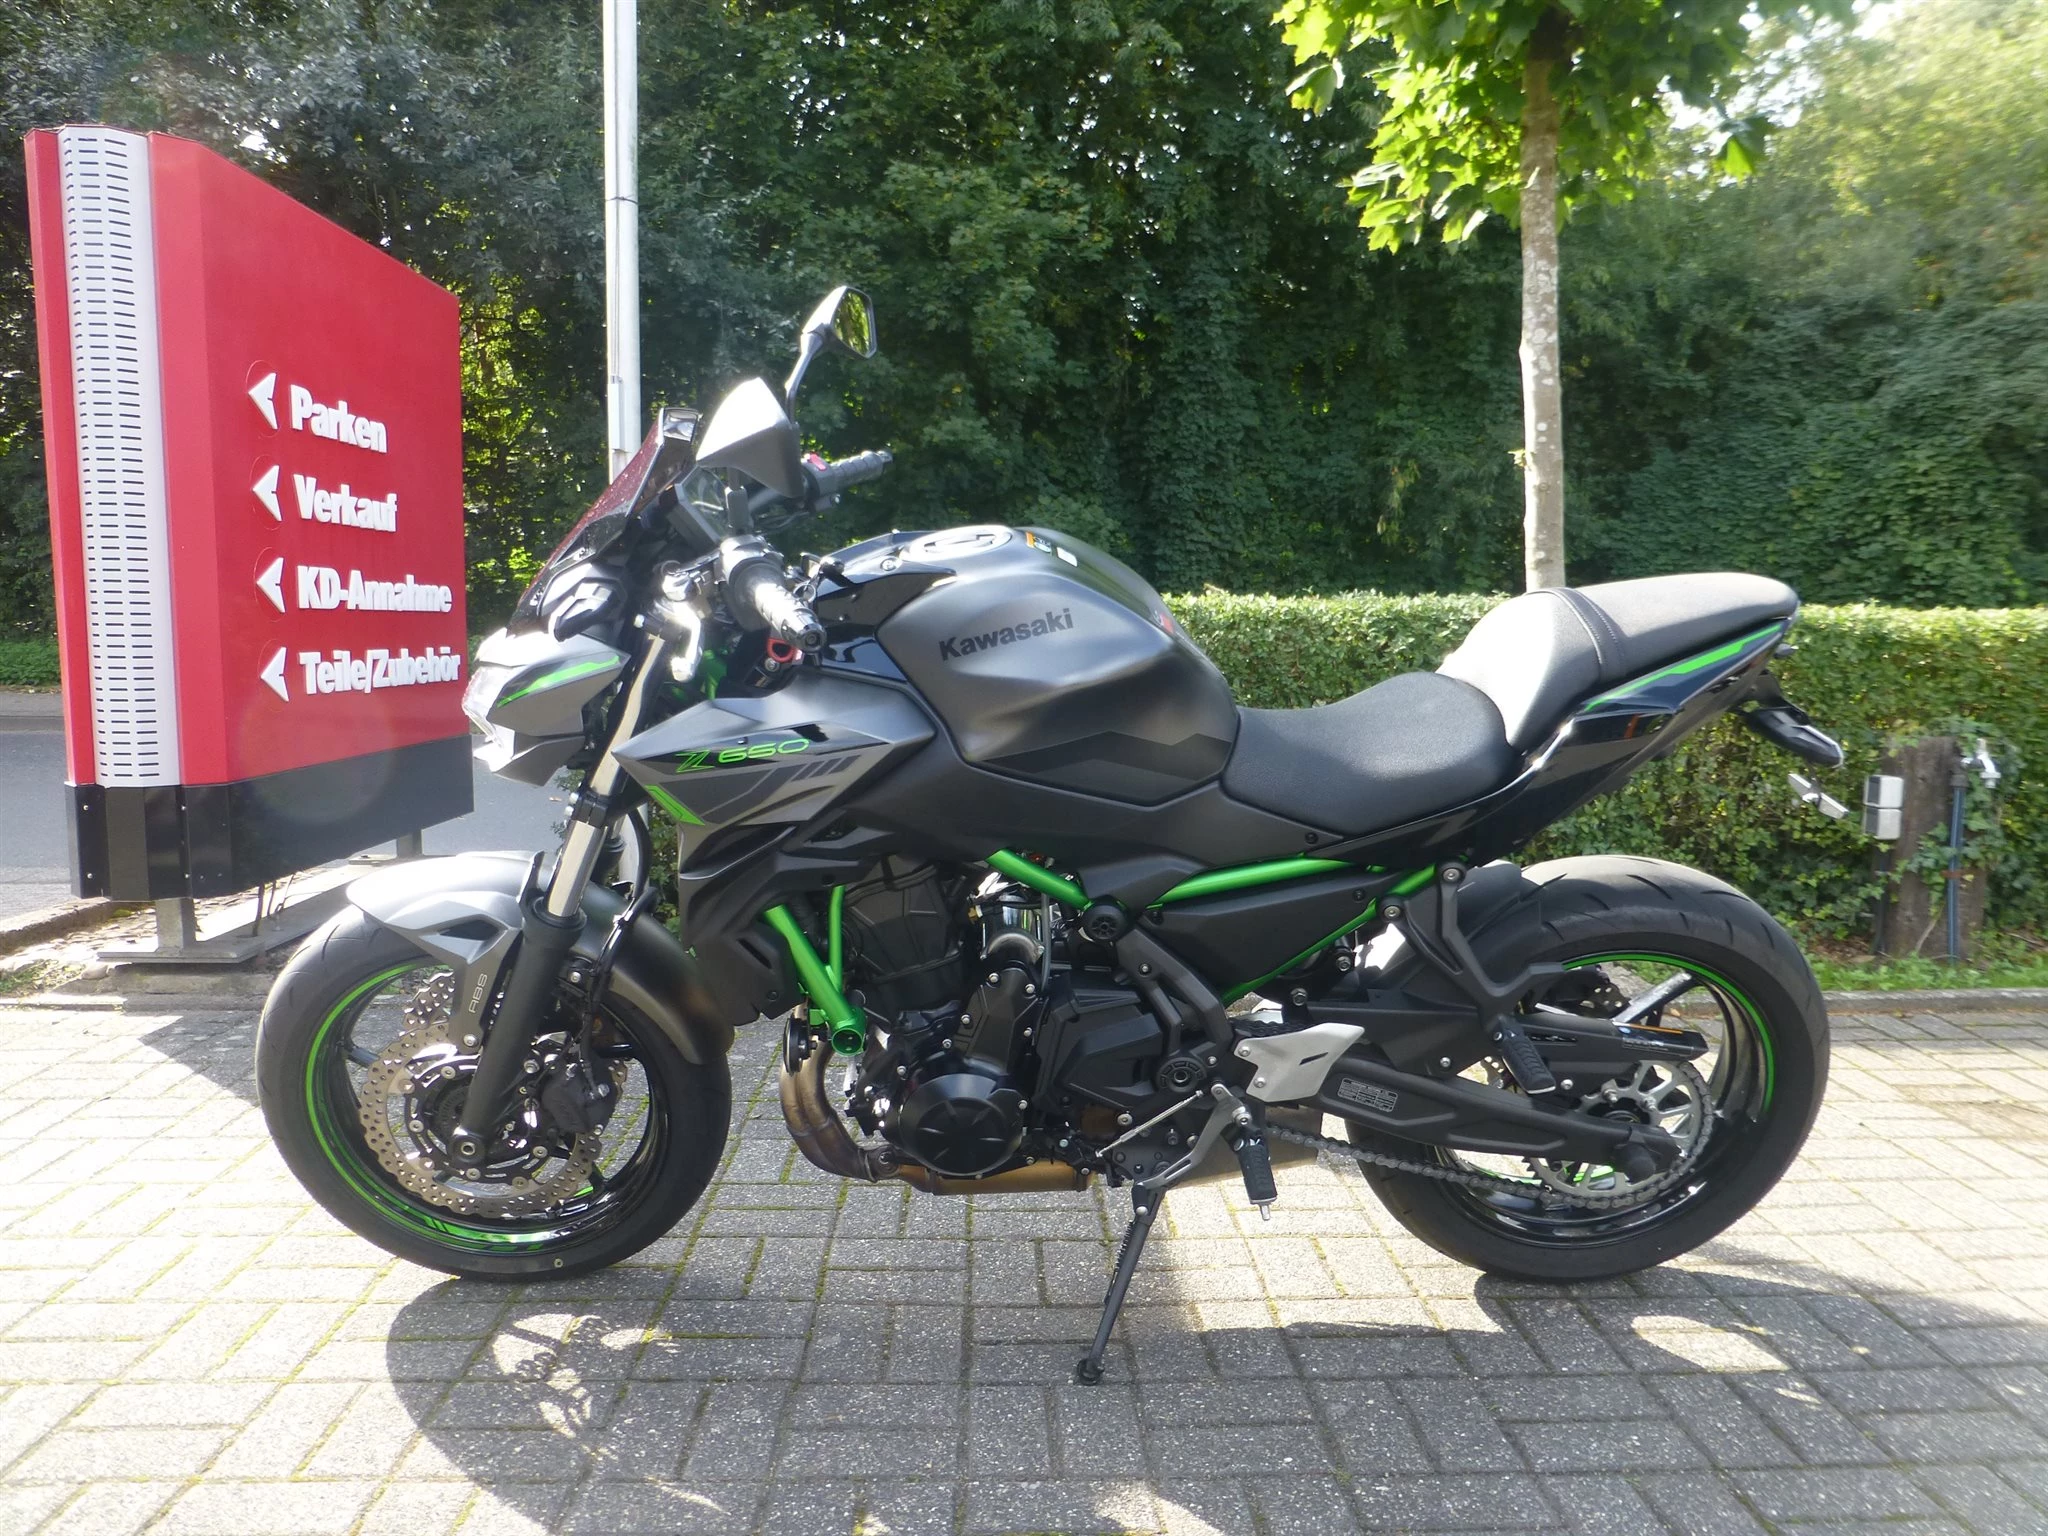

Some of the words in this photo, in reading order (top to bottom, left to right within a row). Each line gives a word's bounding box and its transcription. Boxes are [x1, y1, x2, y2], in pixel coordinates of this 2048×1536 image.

[290, 384, 387, 453] Parken
[293, 473, 398, 532] Verkauf
[297, 565, 452, 612] KD-Annahme
[939, 608, 1074, 661] Kawasaki
[299, 647, 460, 694] Teile/Zubehör
[718, 738, 810, 763] 650
[468, 973, 488, 1014] ABS
